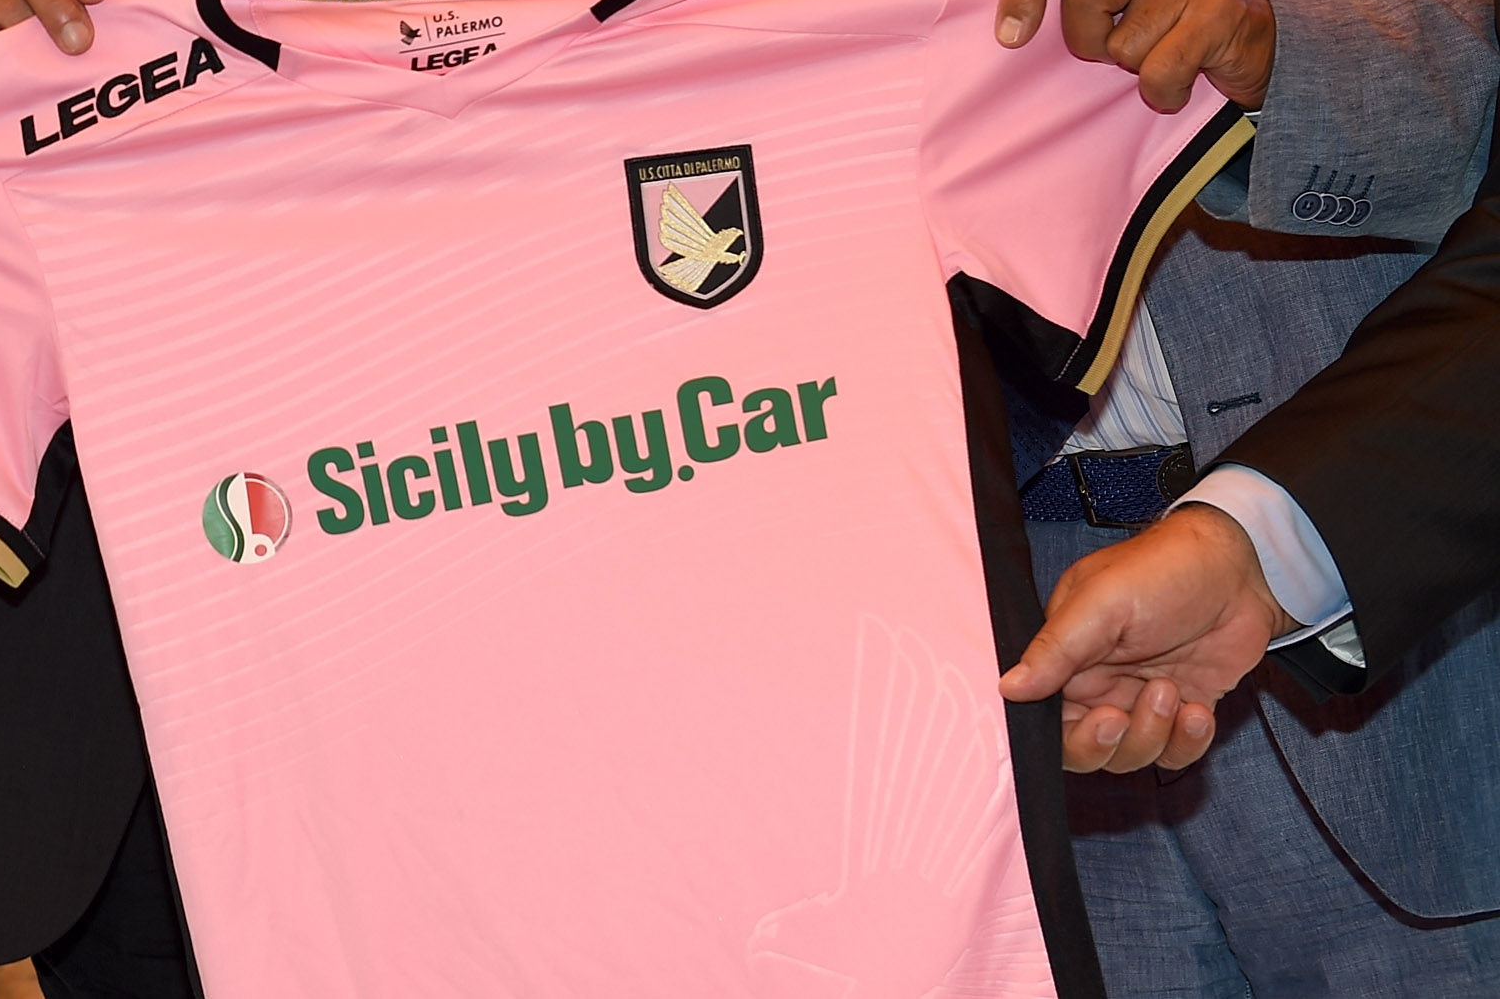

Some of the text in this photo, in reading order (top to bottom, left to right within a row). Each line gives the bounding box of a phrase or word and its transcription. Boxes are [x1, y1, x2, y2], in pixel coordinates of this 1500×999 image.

[433, 10, 459, 23] U.S.
[436, 16, 503, 38] PALERMO
[20, 36, 225, 156] LEGEA
[684, 162, 695, 175] DI
[696, 156, 741, 174] PALERMO
[306, 420, 549, 535] Sicily
